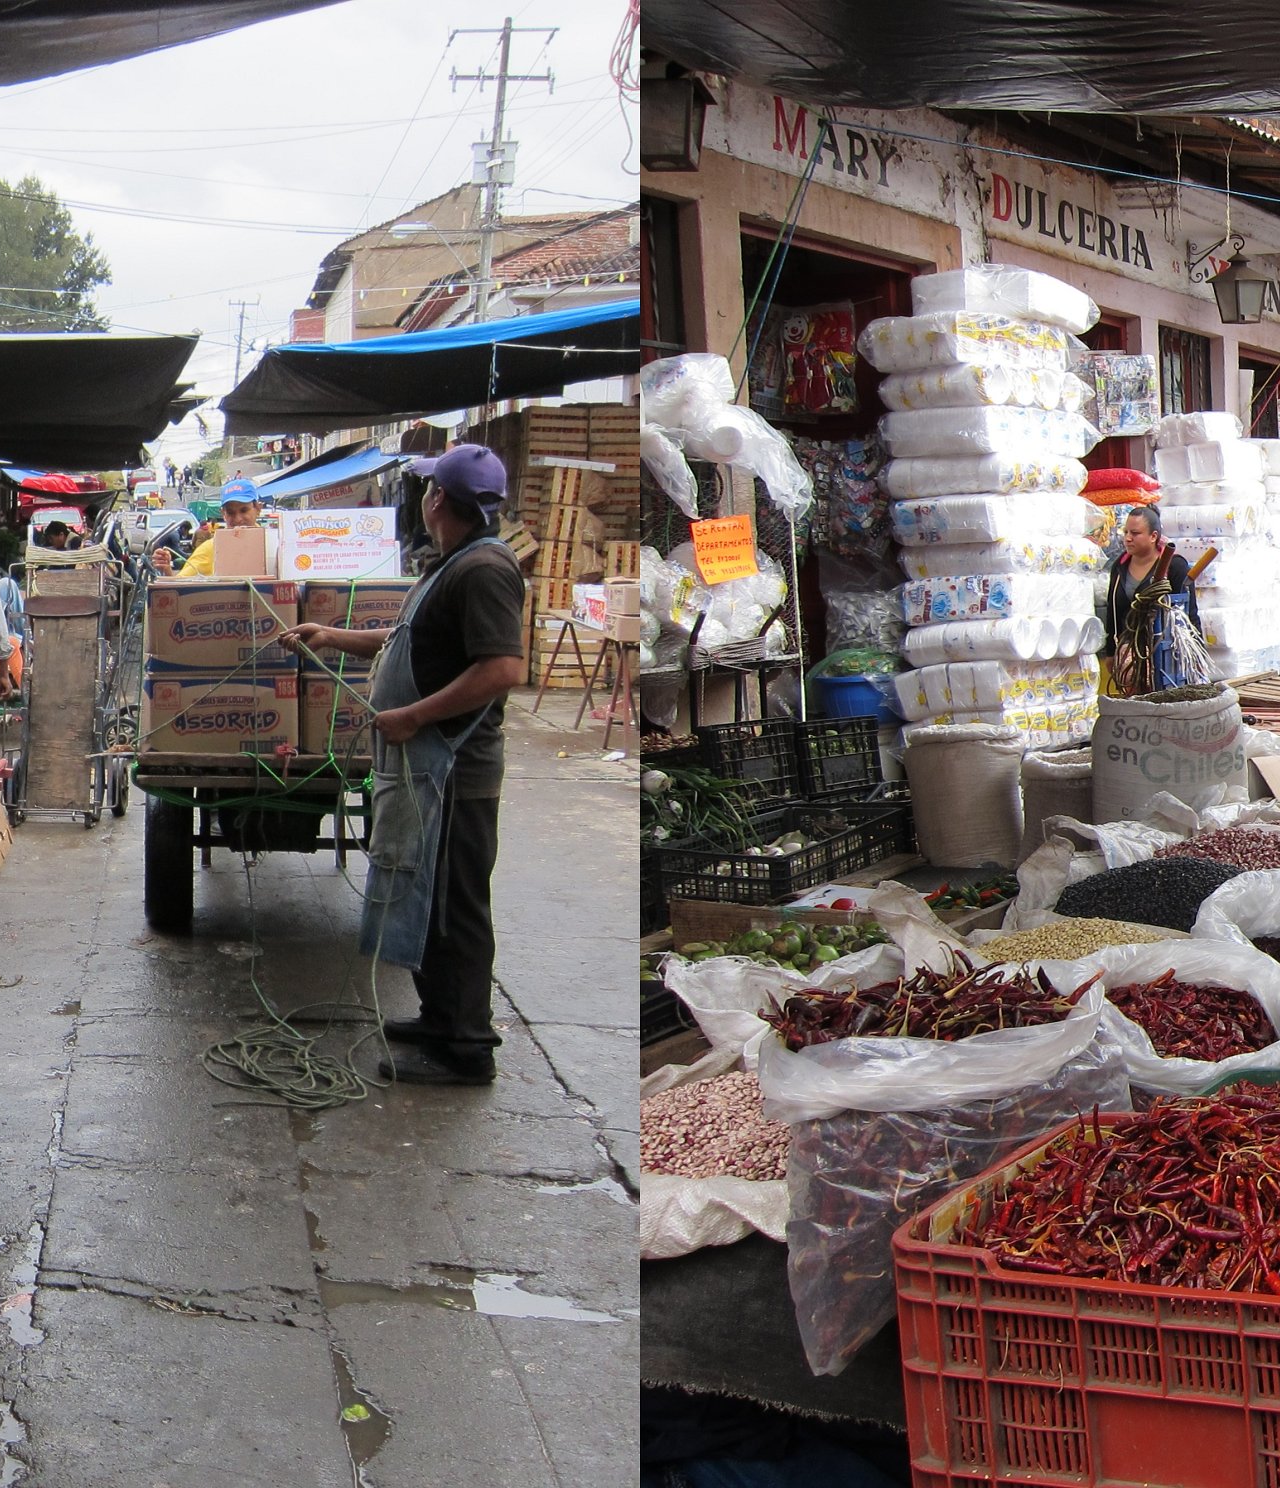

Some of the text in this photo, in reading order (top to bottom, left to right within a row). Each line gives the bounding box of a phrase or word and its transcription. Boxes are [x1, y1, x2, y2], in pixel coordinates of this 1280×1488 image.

[773, 96, 898, 188] MARY
[992, 173, 1154, 271] DULCERIA
[313, 485, 354, 502] CREMERIA
[695, 525, 708, 537] SE
[696, 537, 753, 552] DEPARTAMENTOS
[275, 586, 296, 601] 1654
[171, 617, 276, 641] ASSORTED
[173, 710, 278, 733] ASSORTED
[1111, 718, 1163, 746] Solo
[1172, 718, 1227, 742] Mejor
[1107, 744, 1245, 784] en Chiles
